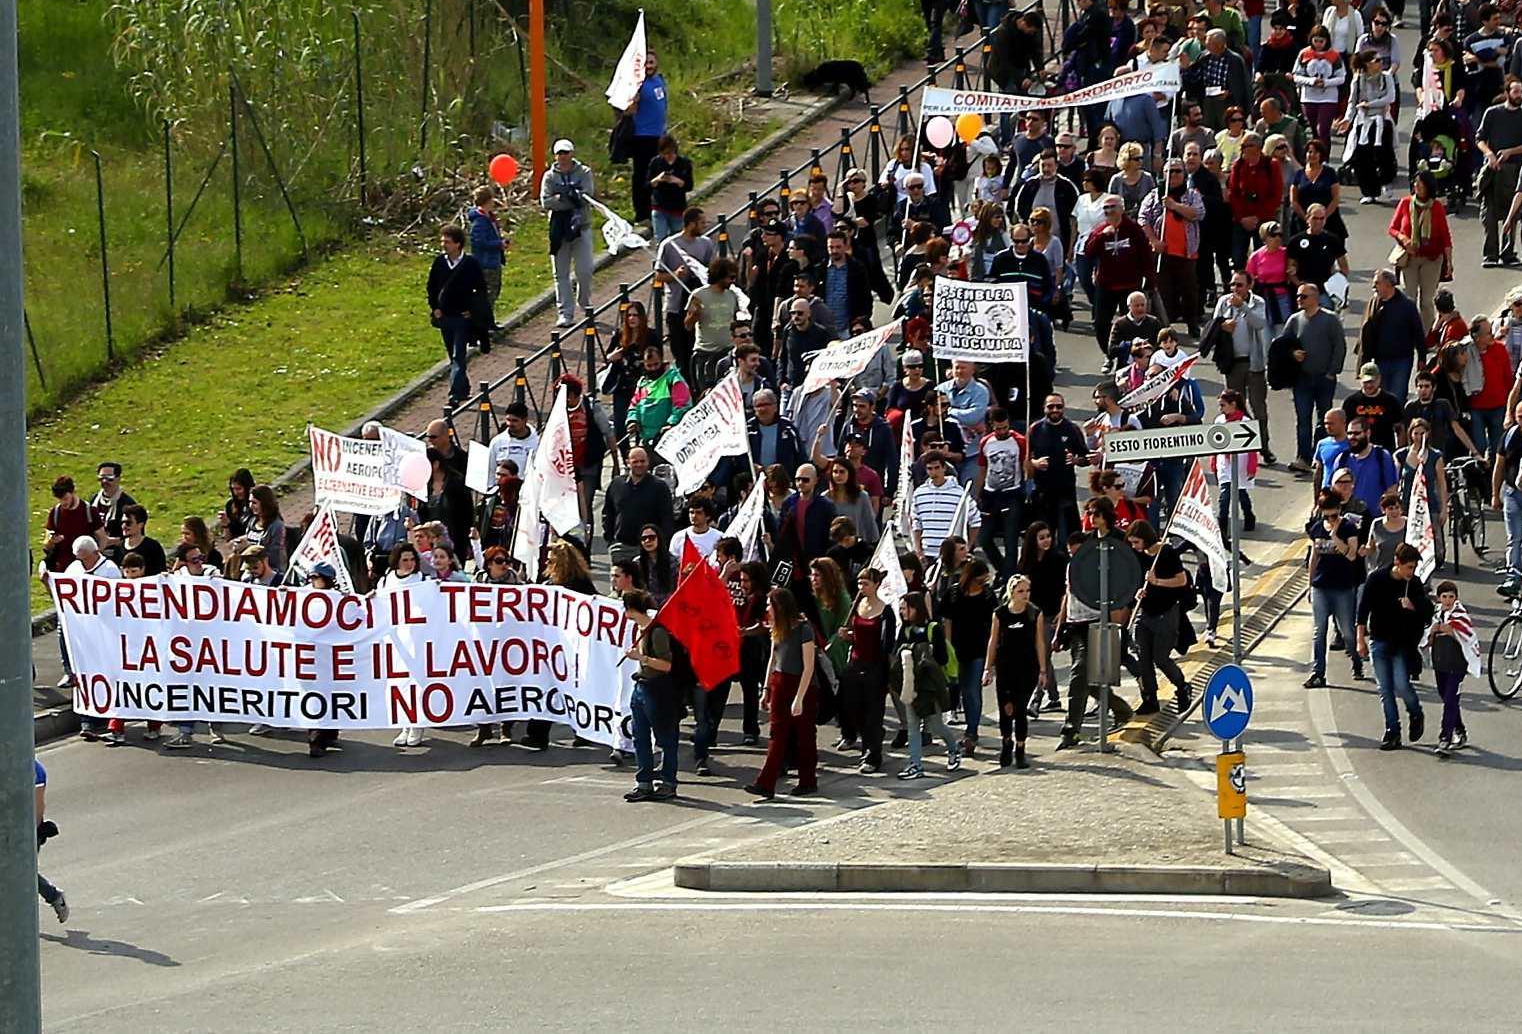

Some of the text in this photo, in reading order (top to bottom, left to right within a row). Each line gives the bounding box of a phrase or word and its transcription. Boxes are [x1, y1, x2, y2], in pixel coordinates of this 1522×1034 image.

[953, 93, 1032, 107] COMITATO
[1063, 71, 1154, 103] AEROPORTO
[936, 285, 1015, 302] SSEMBLEA
[312, 430, 342, 473] NO
[1109, 433, 1205, 453] SESTO FIORENTINO
[55, 576, 375, 632] RIPRENDIAMOCI
[390, 590, 428, 626] IL
[121, 633, 161, 672] LA
[169, 632, 316, 682] SALUTE
[331, 644, 356, 681] E
[373, 642, 412, 680] IL
[73, 672, 112, 716] NO
[114, 680, 369, 721] INCENERITORI
[389, 682, 455, 725] NO
